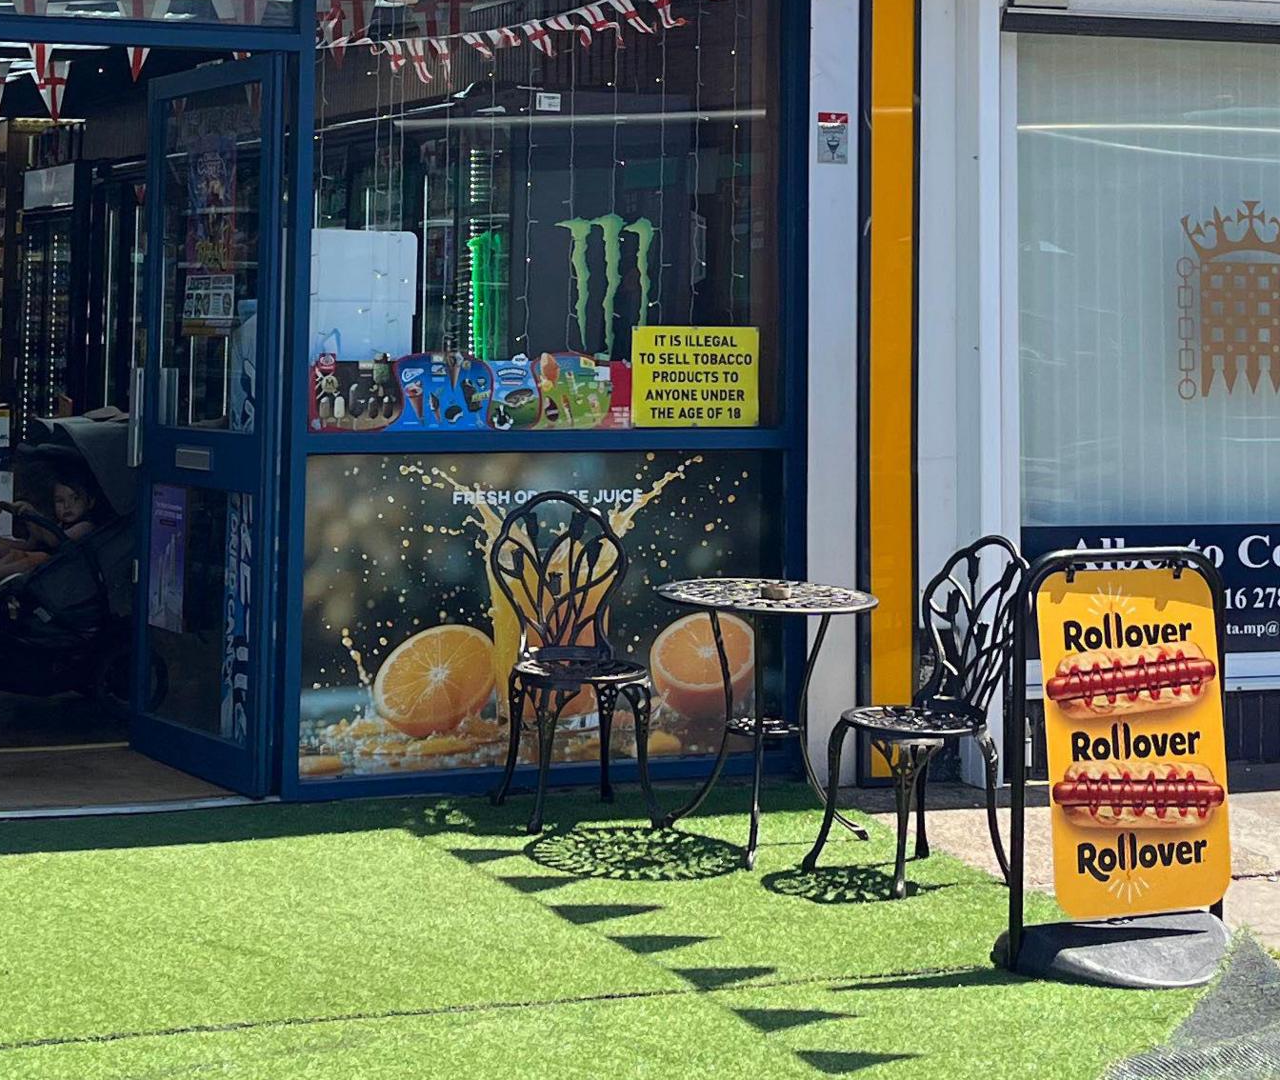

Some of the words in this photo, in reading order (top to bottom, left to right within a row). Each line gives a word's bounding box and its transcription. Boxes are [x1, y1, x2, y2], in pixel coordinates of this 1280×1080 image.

[654, 334, 666, 347] IT
[669, 334, 682, 347] IS
[685, 335, 738, 348] ILLEGAL
[639, 353, 656, 365] TO
[658, 353, 690, 366] SELL
[693, 353, 753, 366] TOBACCO
[652, 370, 719, 383] PRODUCTS
[722, 371, 739, 383] TO
[645, 388, 698, 401] ANYONE
[701, 389, 745, 402] UNDER
[650, 407, 675, 419] THE
[678, 407, 704, 419] AGE
[707, 408, 723, 419] OF
[727, 407, 741, 419] 18
[452, 490, 511, 505] FRESH
[593, 488, 644, 505] JUICE
[1063, 611, 1192, 652] Rollover
[1071, 721, 1200, 762] Rollover
[1077, 831, 1207, 883] Rollover
